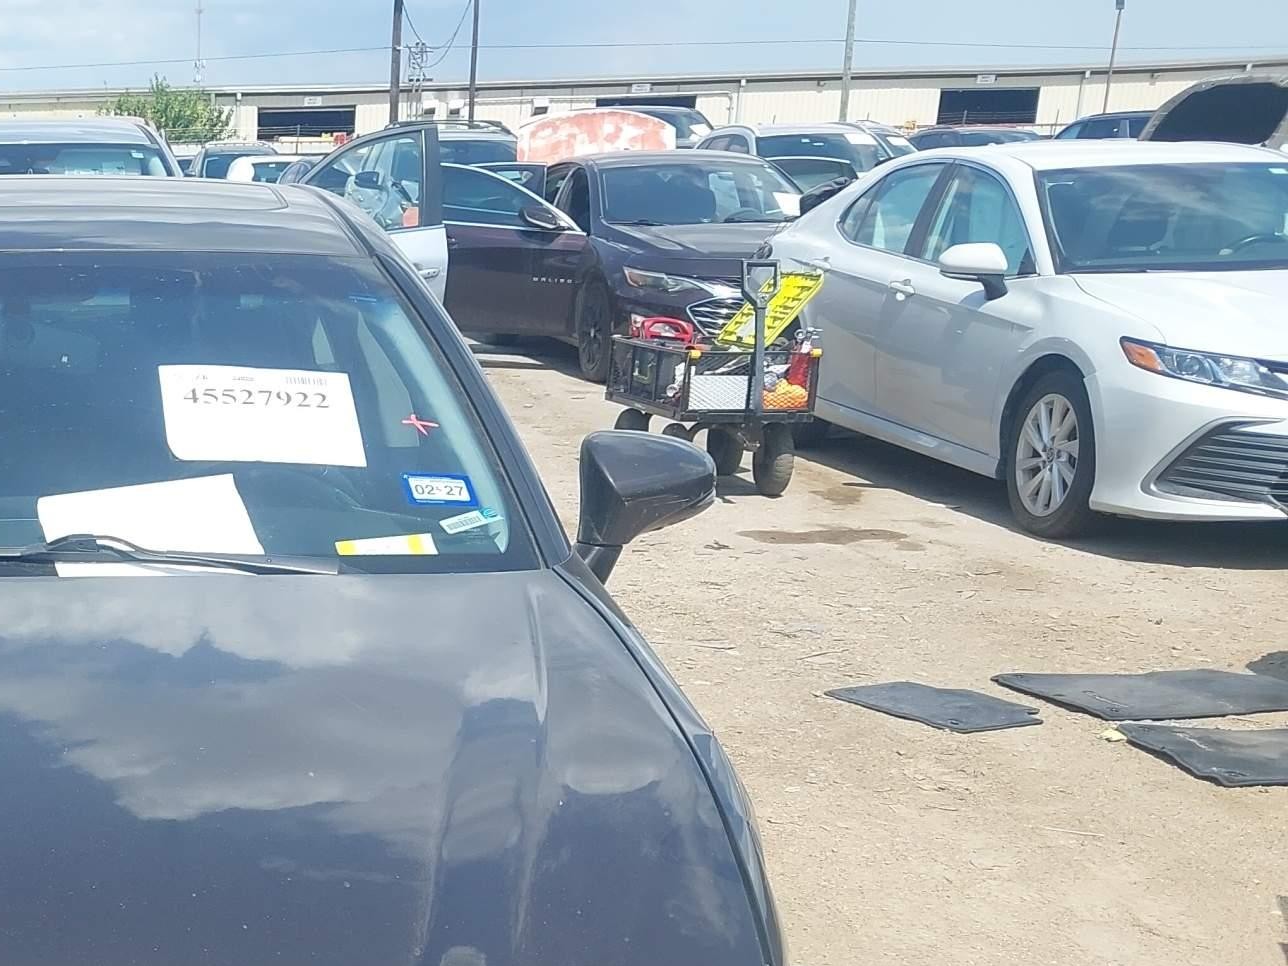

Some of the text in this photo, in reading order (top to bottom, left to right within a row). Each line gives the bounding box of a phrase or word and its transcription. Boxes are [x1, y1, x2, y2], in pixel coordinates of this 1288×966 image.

[183, 387, 330, 408] 45527922
[414, 484, 464, 497] 02 27
